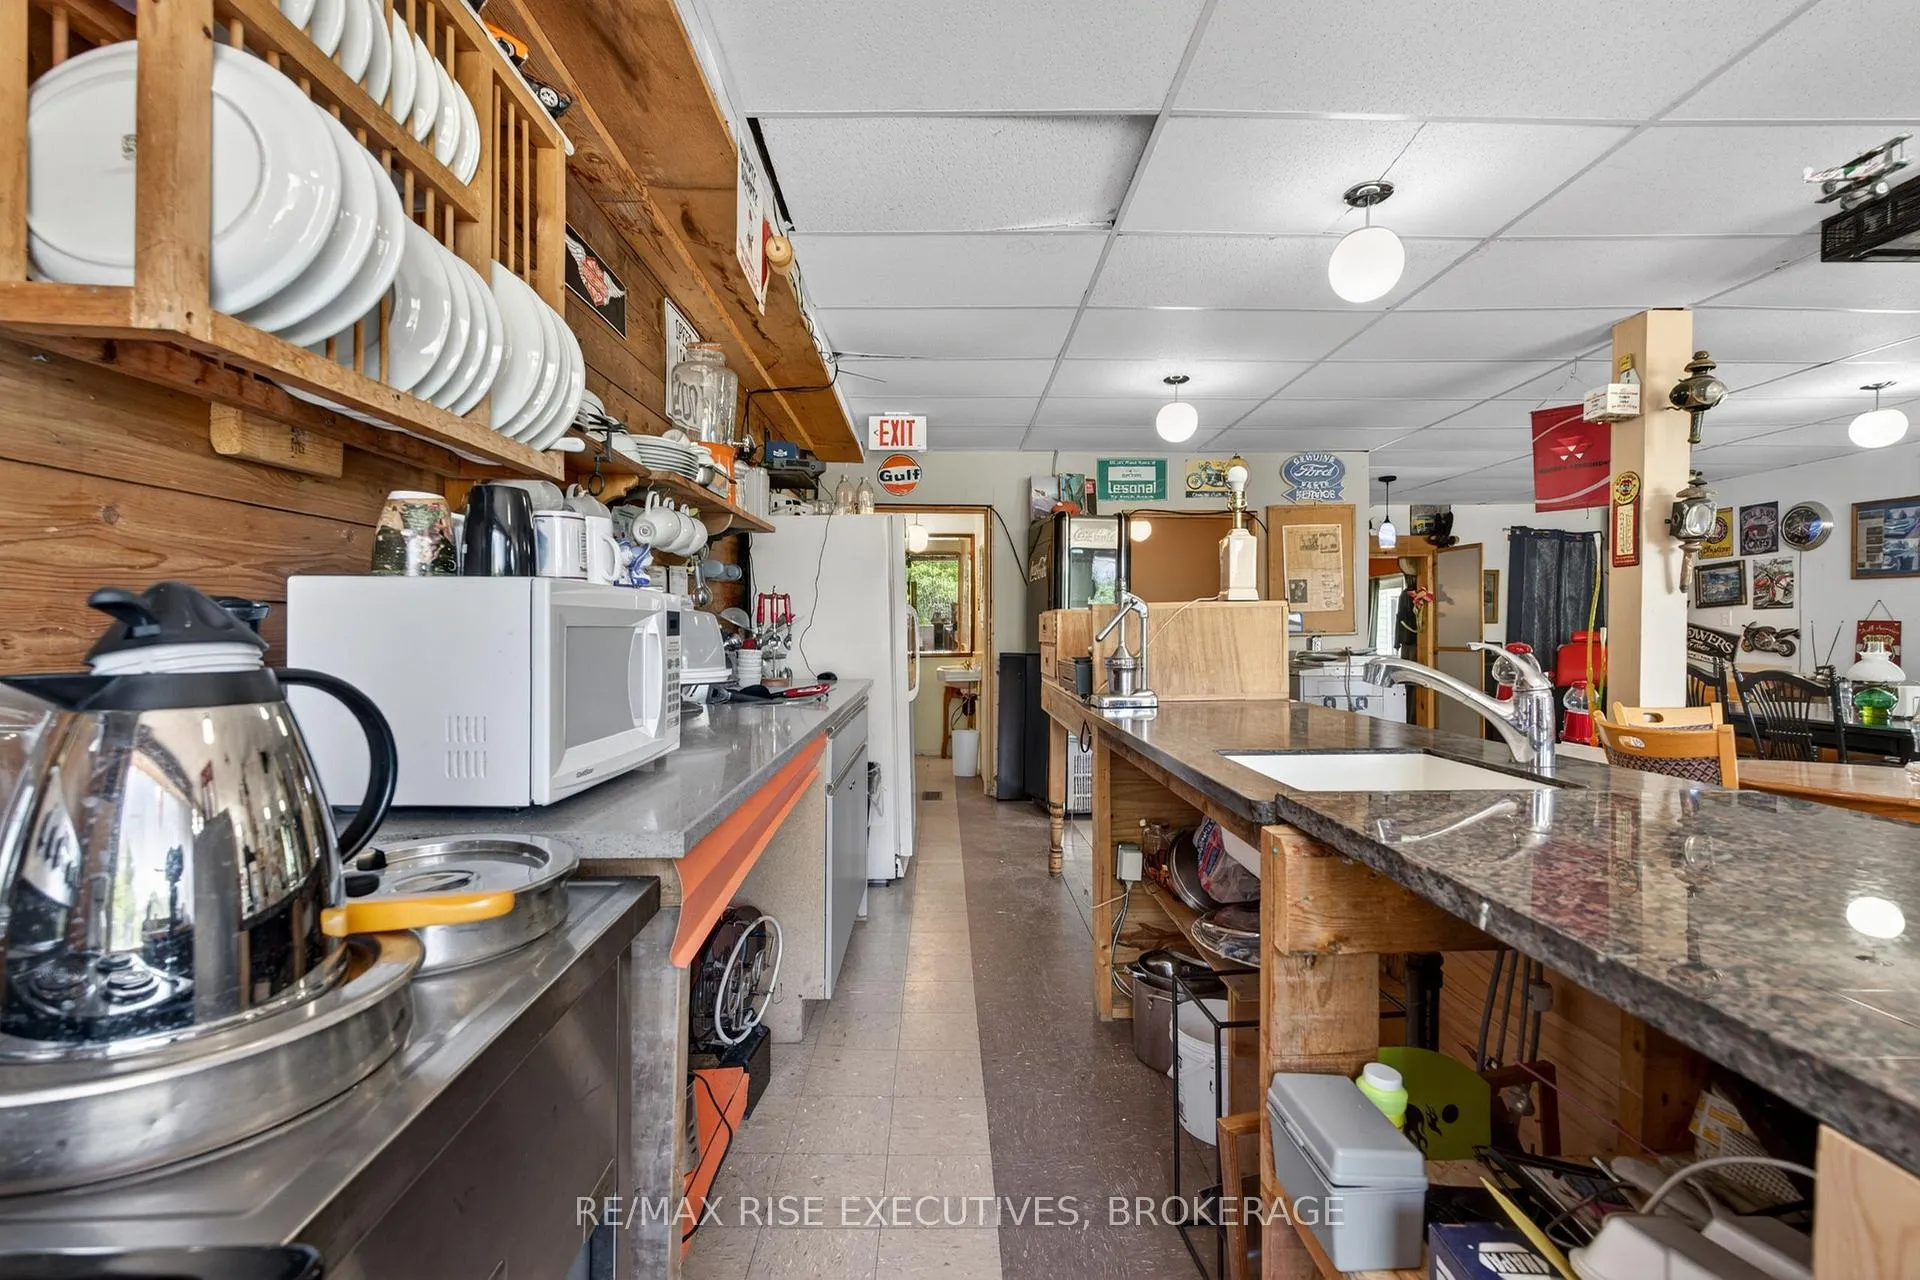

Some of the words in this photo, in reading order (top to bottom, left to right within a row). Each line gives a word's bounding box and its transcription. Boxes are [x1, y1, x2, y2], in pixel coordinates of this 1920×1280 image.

[879, 419, 916, 447] EXIT
[879, 468, 921, 482] Gulf
[1293, 463, 1337, 477] Ford
